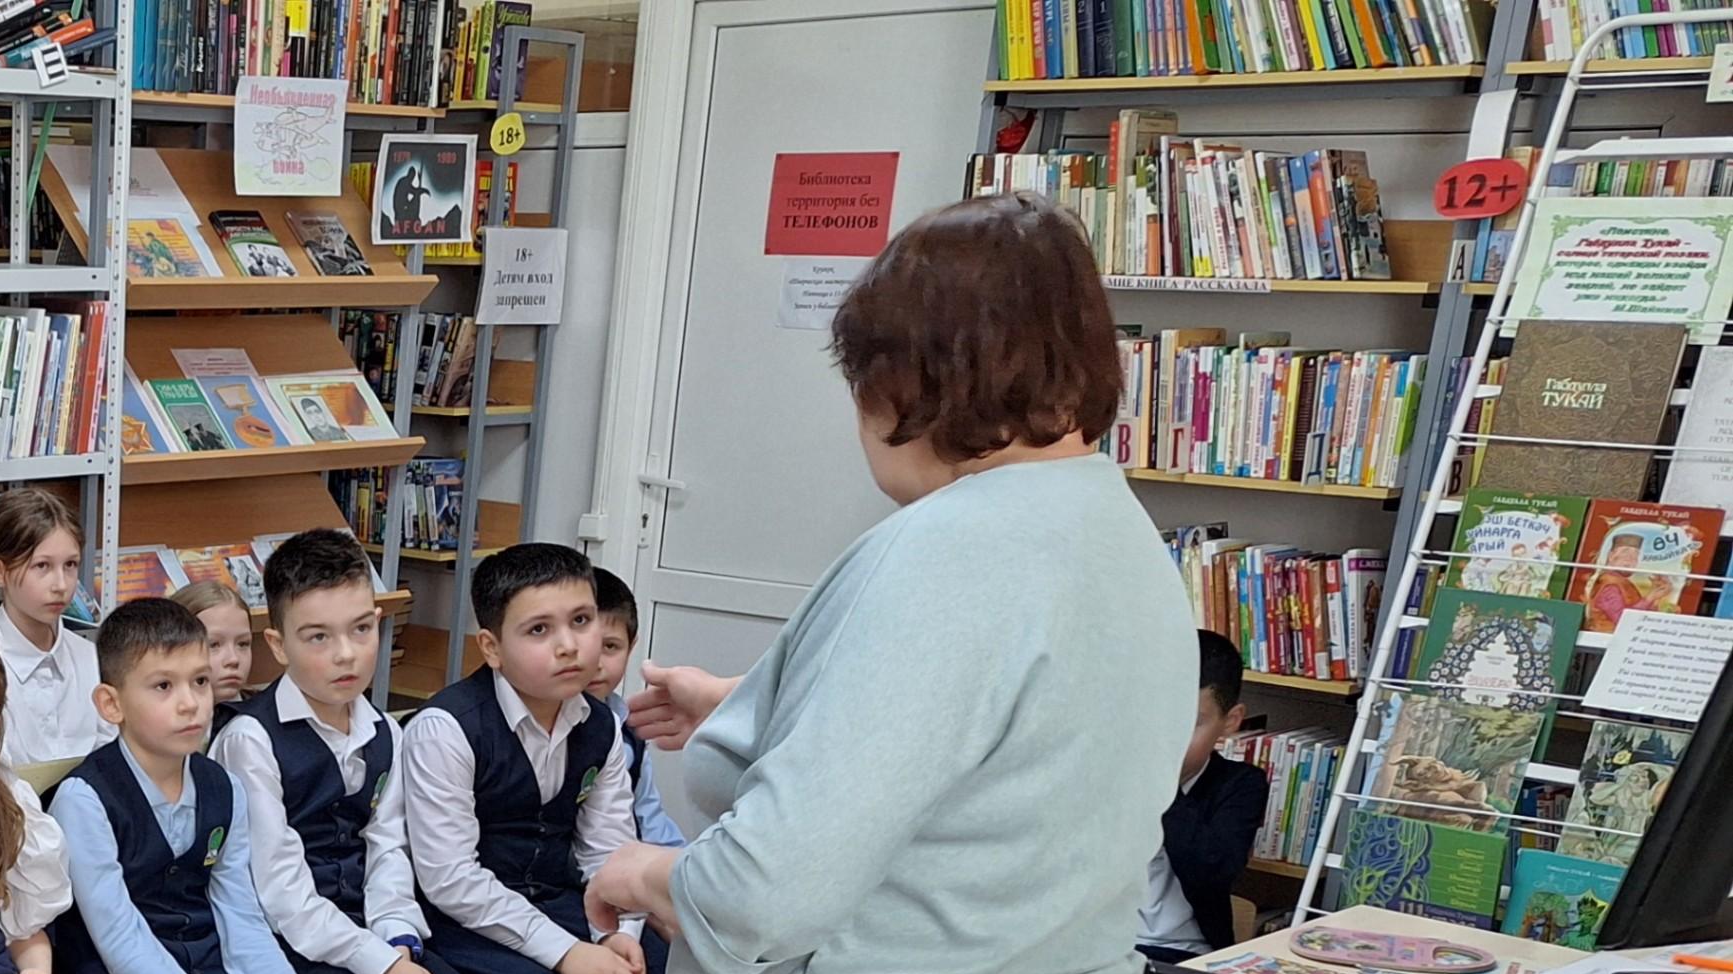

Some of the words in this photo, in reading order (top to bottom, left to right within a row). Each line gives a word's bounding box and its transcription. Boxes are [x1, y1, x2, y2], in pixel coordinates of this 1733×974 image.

[499, 127, 521, 148] 18+
[273, 159, 306, 175] война
[799, 170, 871, 187] Библиотека
[1442, 173, 1518, 210] 12+
[786, 194, 855, 211] территория
[859, 192, 880, 208] без
[391, 219, 446, 235] AFGAN
[783, 214, 879, 230] ТЕЛЕФОНОВ
[1641, 239, 1681, 247] Тукай
[514, 248, 533, 263] 18+
[1453, 251, 1465, 279] А
[493, 269, 524, 286] Детям
[527, 270, 553, 285] вход
[1107, 276, 1133, 289] МНЕ
[1138, 277, 1179, 290] КНИГА
[1184, 278, 1268, 292] РАССКАЗАЛА
[495, 293, 546, 309] запрещен
[1546, 378, 1607, 393] Габдулла
[1541, 391, 1604, 409] ТУКАЙ
[1117, 430, 1131, 465] В
[1171, 430, 1186, 464] Г
[1449, 462, 1462, 495] В
[1532, 499, 1558, 508] ТУКАЙ
[1485, 514, 1503, 524] ЭШ
[1661, 511, 1689, 519] ТУКАЙ
[1652, 532, 1680, 551] ӨЧ
